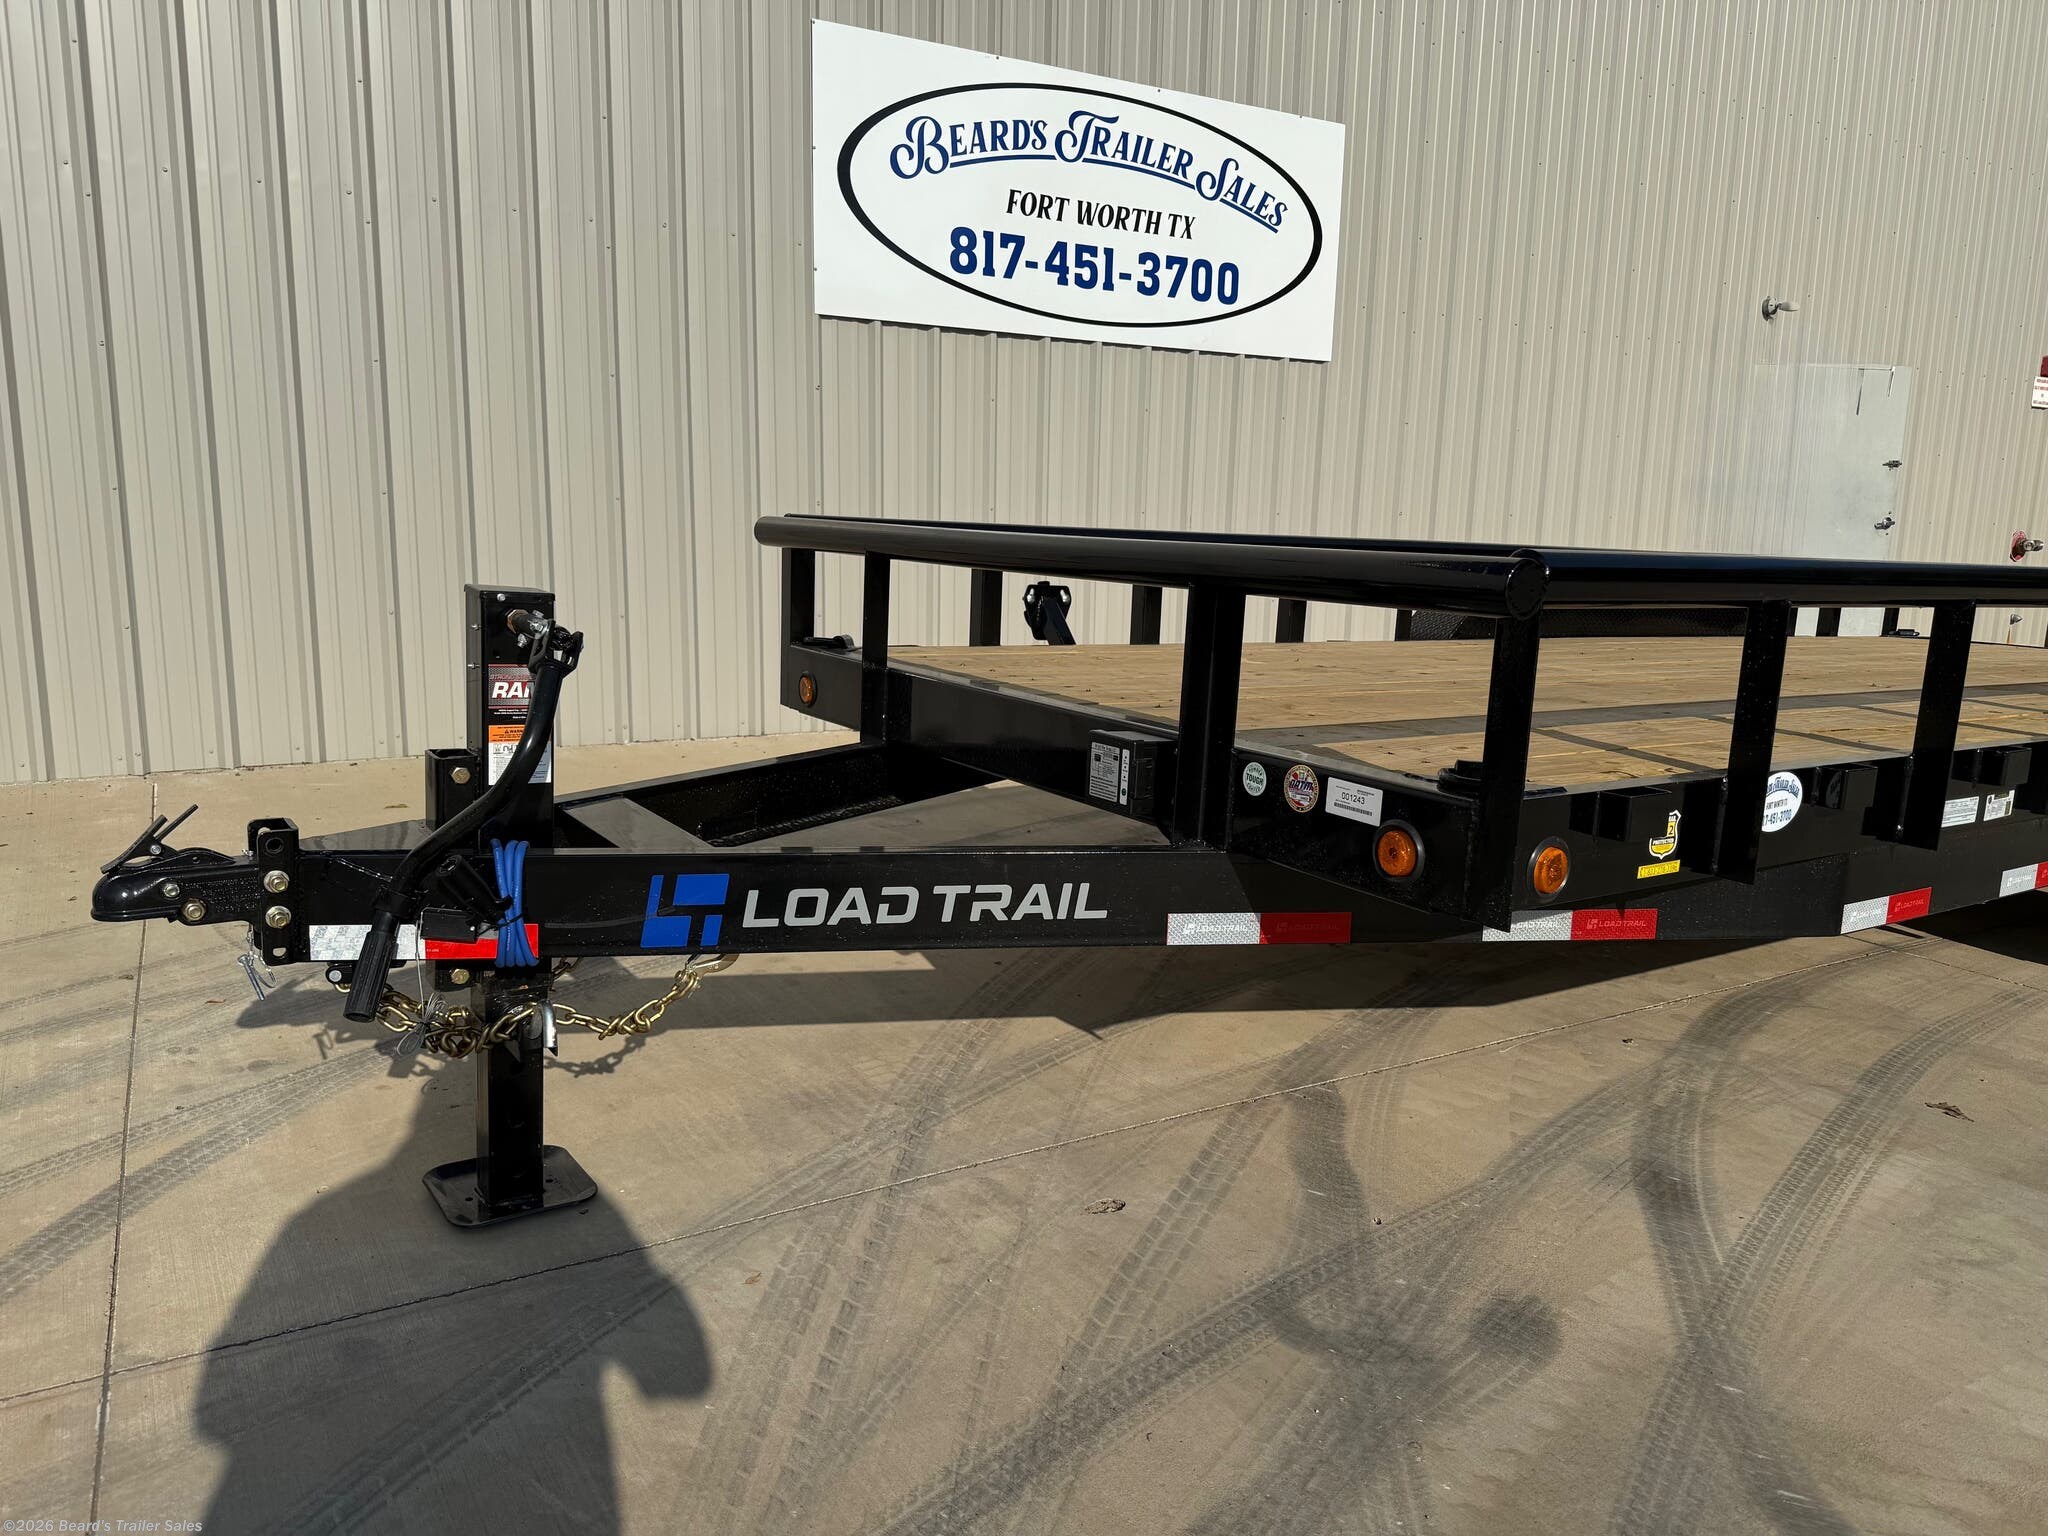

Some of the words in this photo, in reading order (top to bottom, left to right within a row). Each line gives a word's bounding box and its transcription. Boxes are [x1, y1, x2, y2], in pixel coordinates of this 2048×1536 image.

[1054, 110, 1194, 180] TRAILER
[1195, 157, 1289, 229] SALES
[1006, 189, 1071, 223] FORT
[1076, 199, 1162, 236] WORTH
[1166, 213, 1196, 240] TX
[949, 226, 1240, 306] 817-451-3700
[1341, 791, 1366, 805] 001243
[1668, 825, 1674, 835] 2
[742, 885, 920, 929] LOAD
[932, 882, 1108, 923] TRAIL
